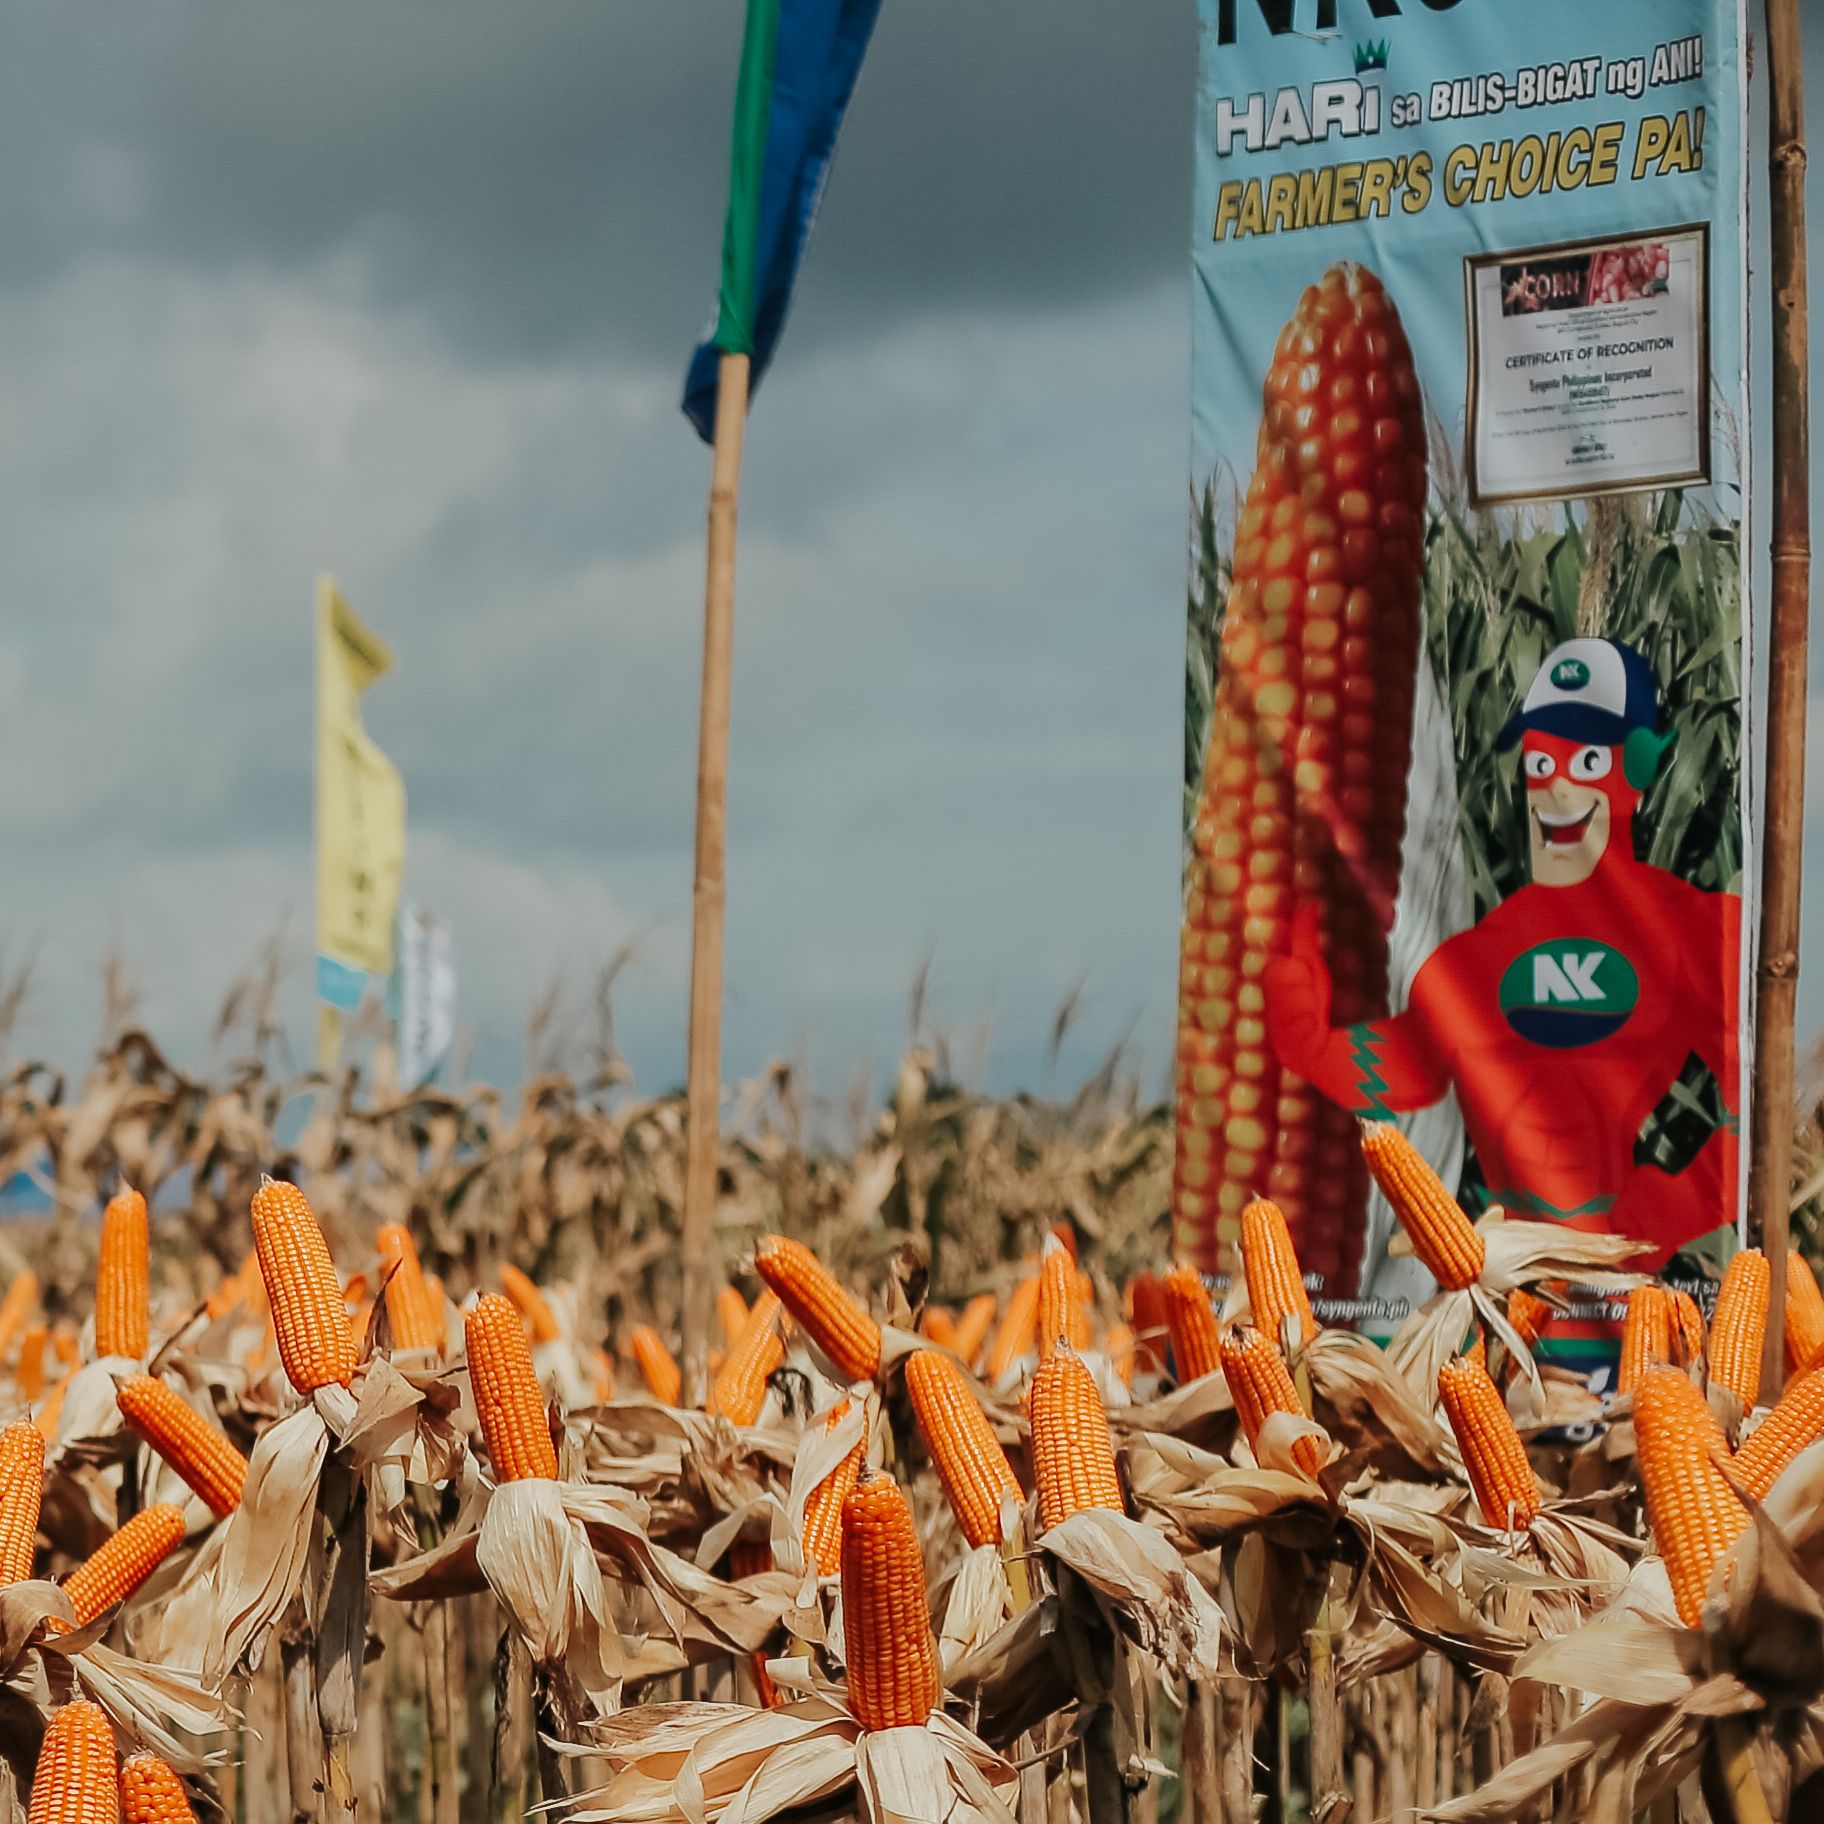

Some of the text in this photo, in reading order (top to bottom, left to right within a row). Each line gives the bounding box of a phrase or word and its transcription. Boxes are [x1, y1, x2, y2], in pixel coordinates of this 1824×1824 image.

[1391, 91, 1423, 128] sa
[1429, 57, 1601, 121] BILIS-BIGAT
[1607, 56, 1643, 96] ng
[1651, 35, 1703, 86] ANI!
[1213, 107, 1705, 243] FARMER'S CHOICE PA!
[1505, 336, 1675, 369] CERTIFICATE OF RECOGNITION
[1532, 951, 1607, 1003] NK
